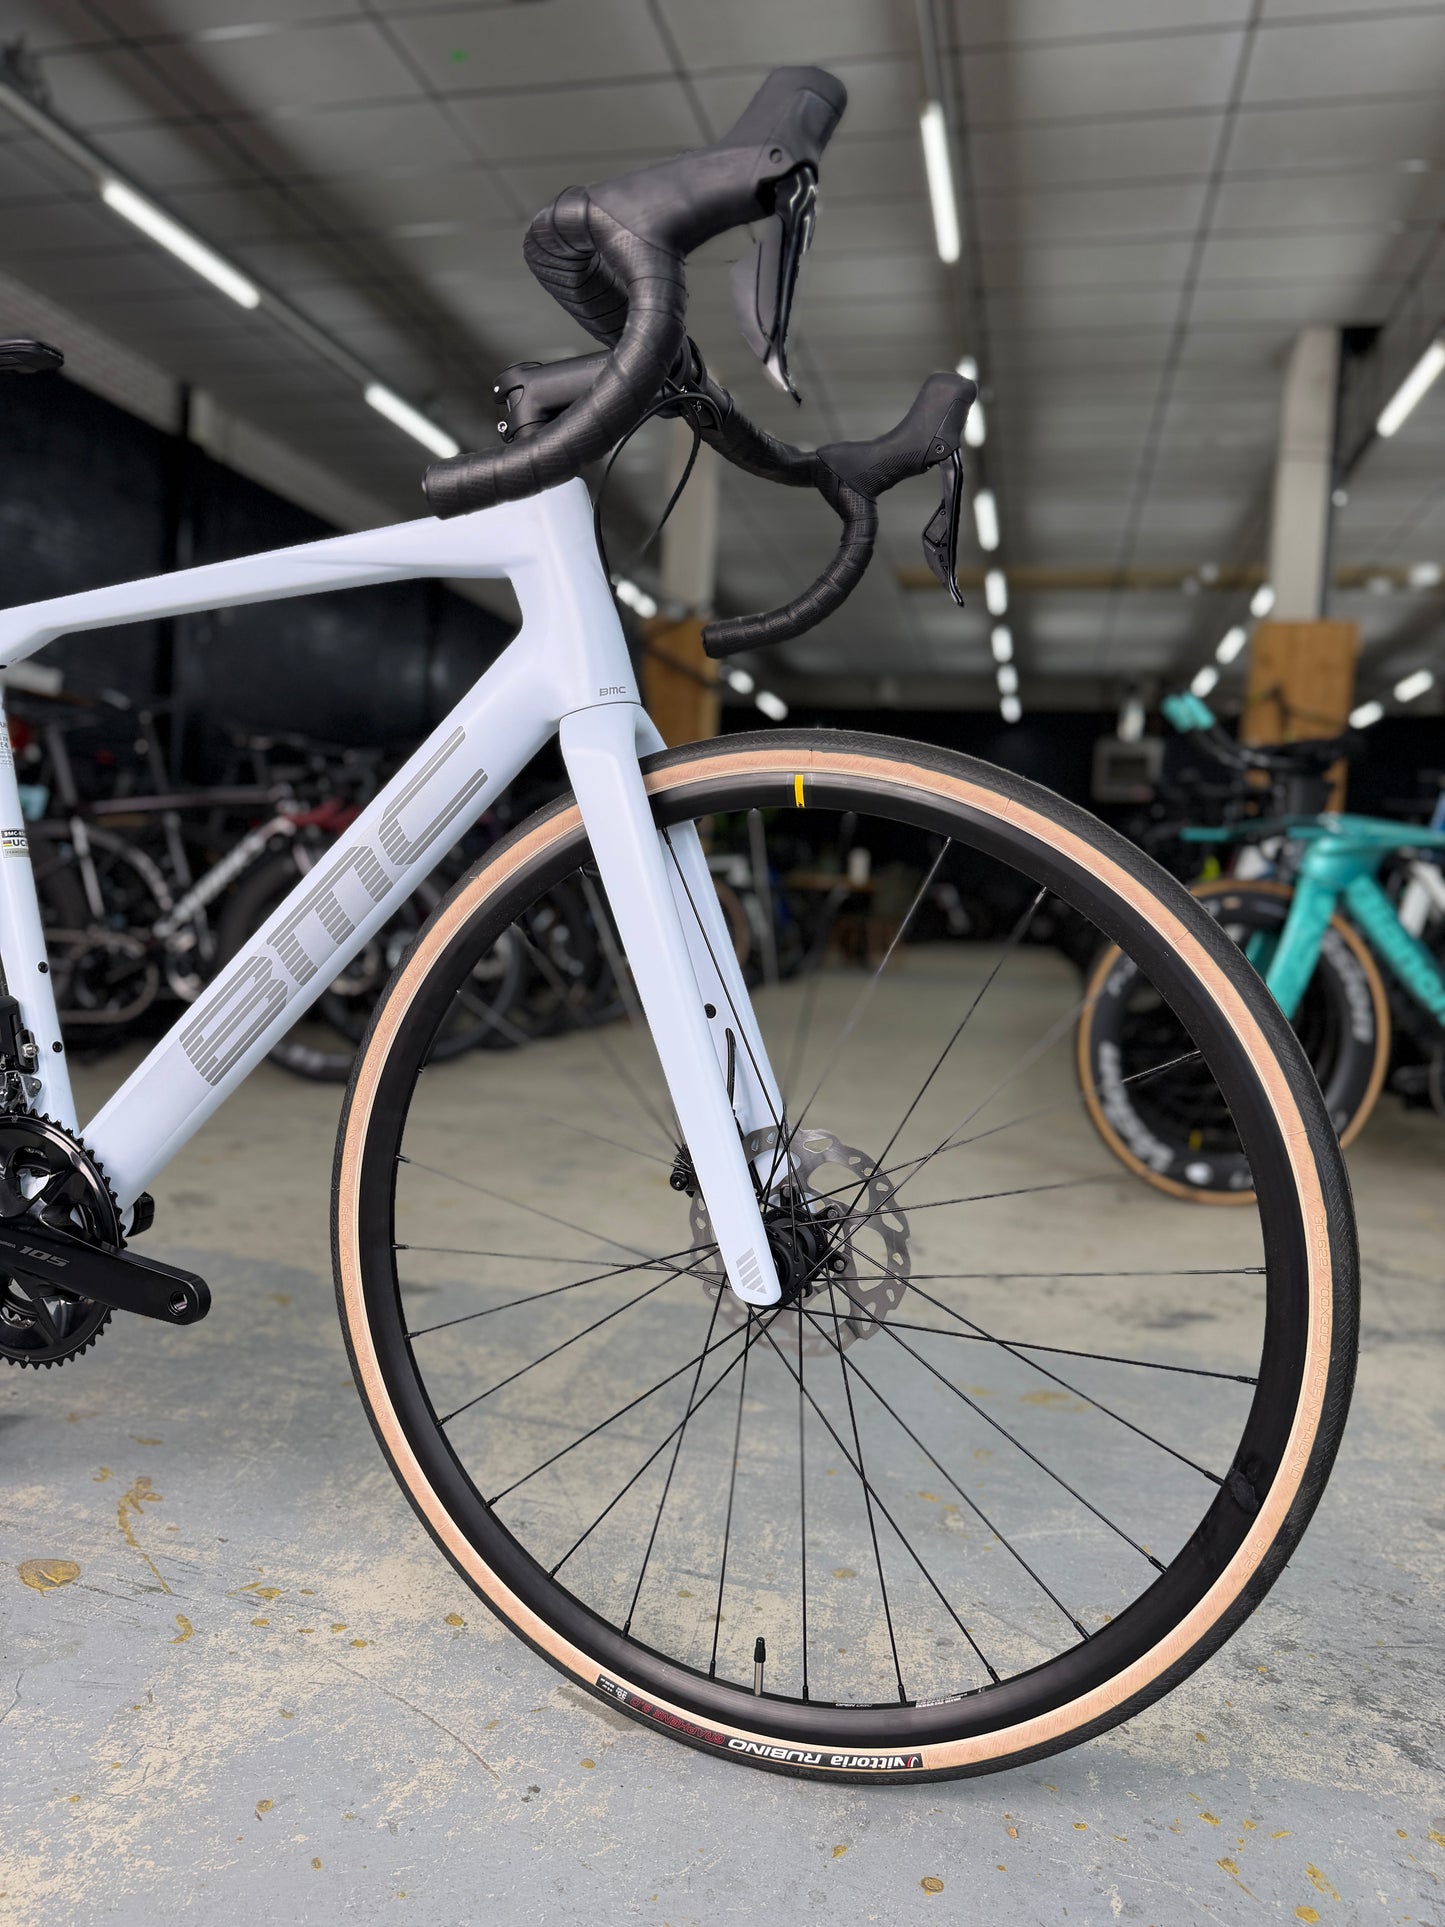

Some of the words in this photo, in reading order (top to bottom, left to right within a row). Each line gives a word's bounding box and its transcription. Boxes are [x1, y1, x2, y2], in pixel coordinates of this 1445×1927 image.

[599, 686, 626, 697] BMC
[179, 726, 489, 1087] BMC
[19, 1245, 70, 1267] 105
[1311, 1355, 1327, 1397] MADE
[1308, 1398, 1320, 1413] IN
[1287, 1414, 1317, 1480] THAILAND
[726, 1735, 822, 1765] RUBINO
[829, 1754, 906, 1769] vittoria
